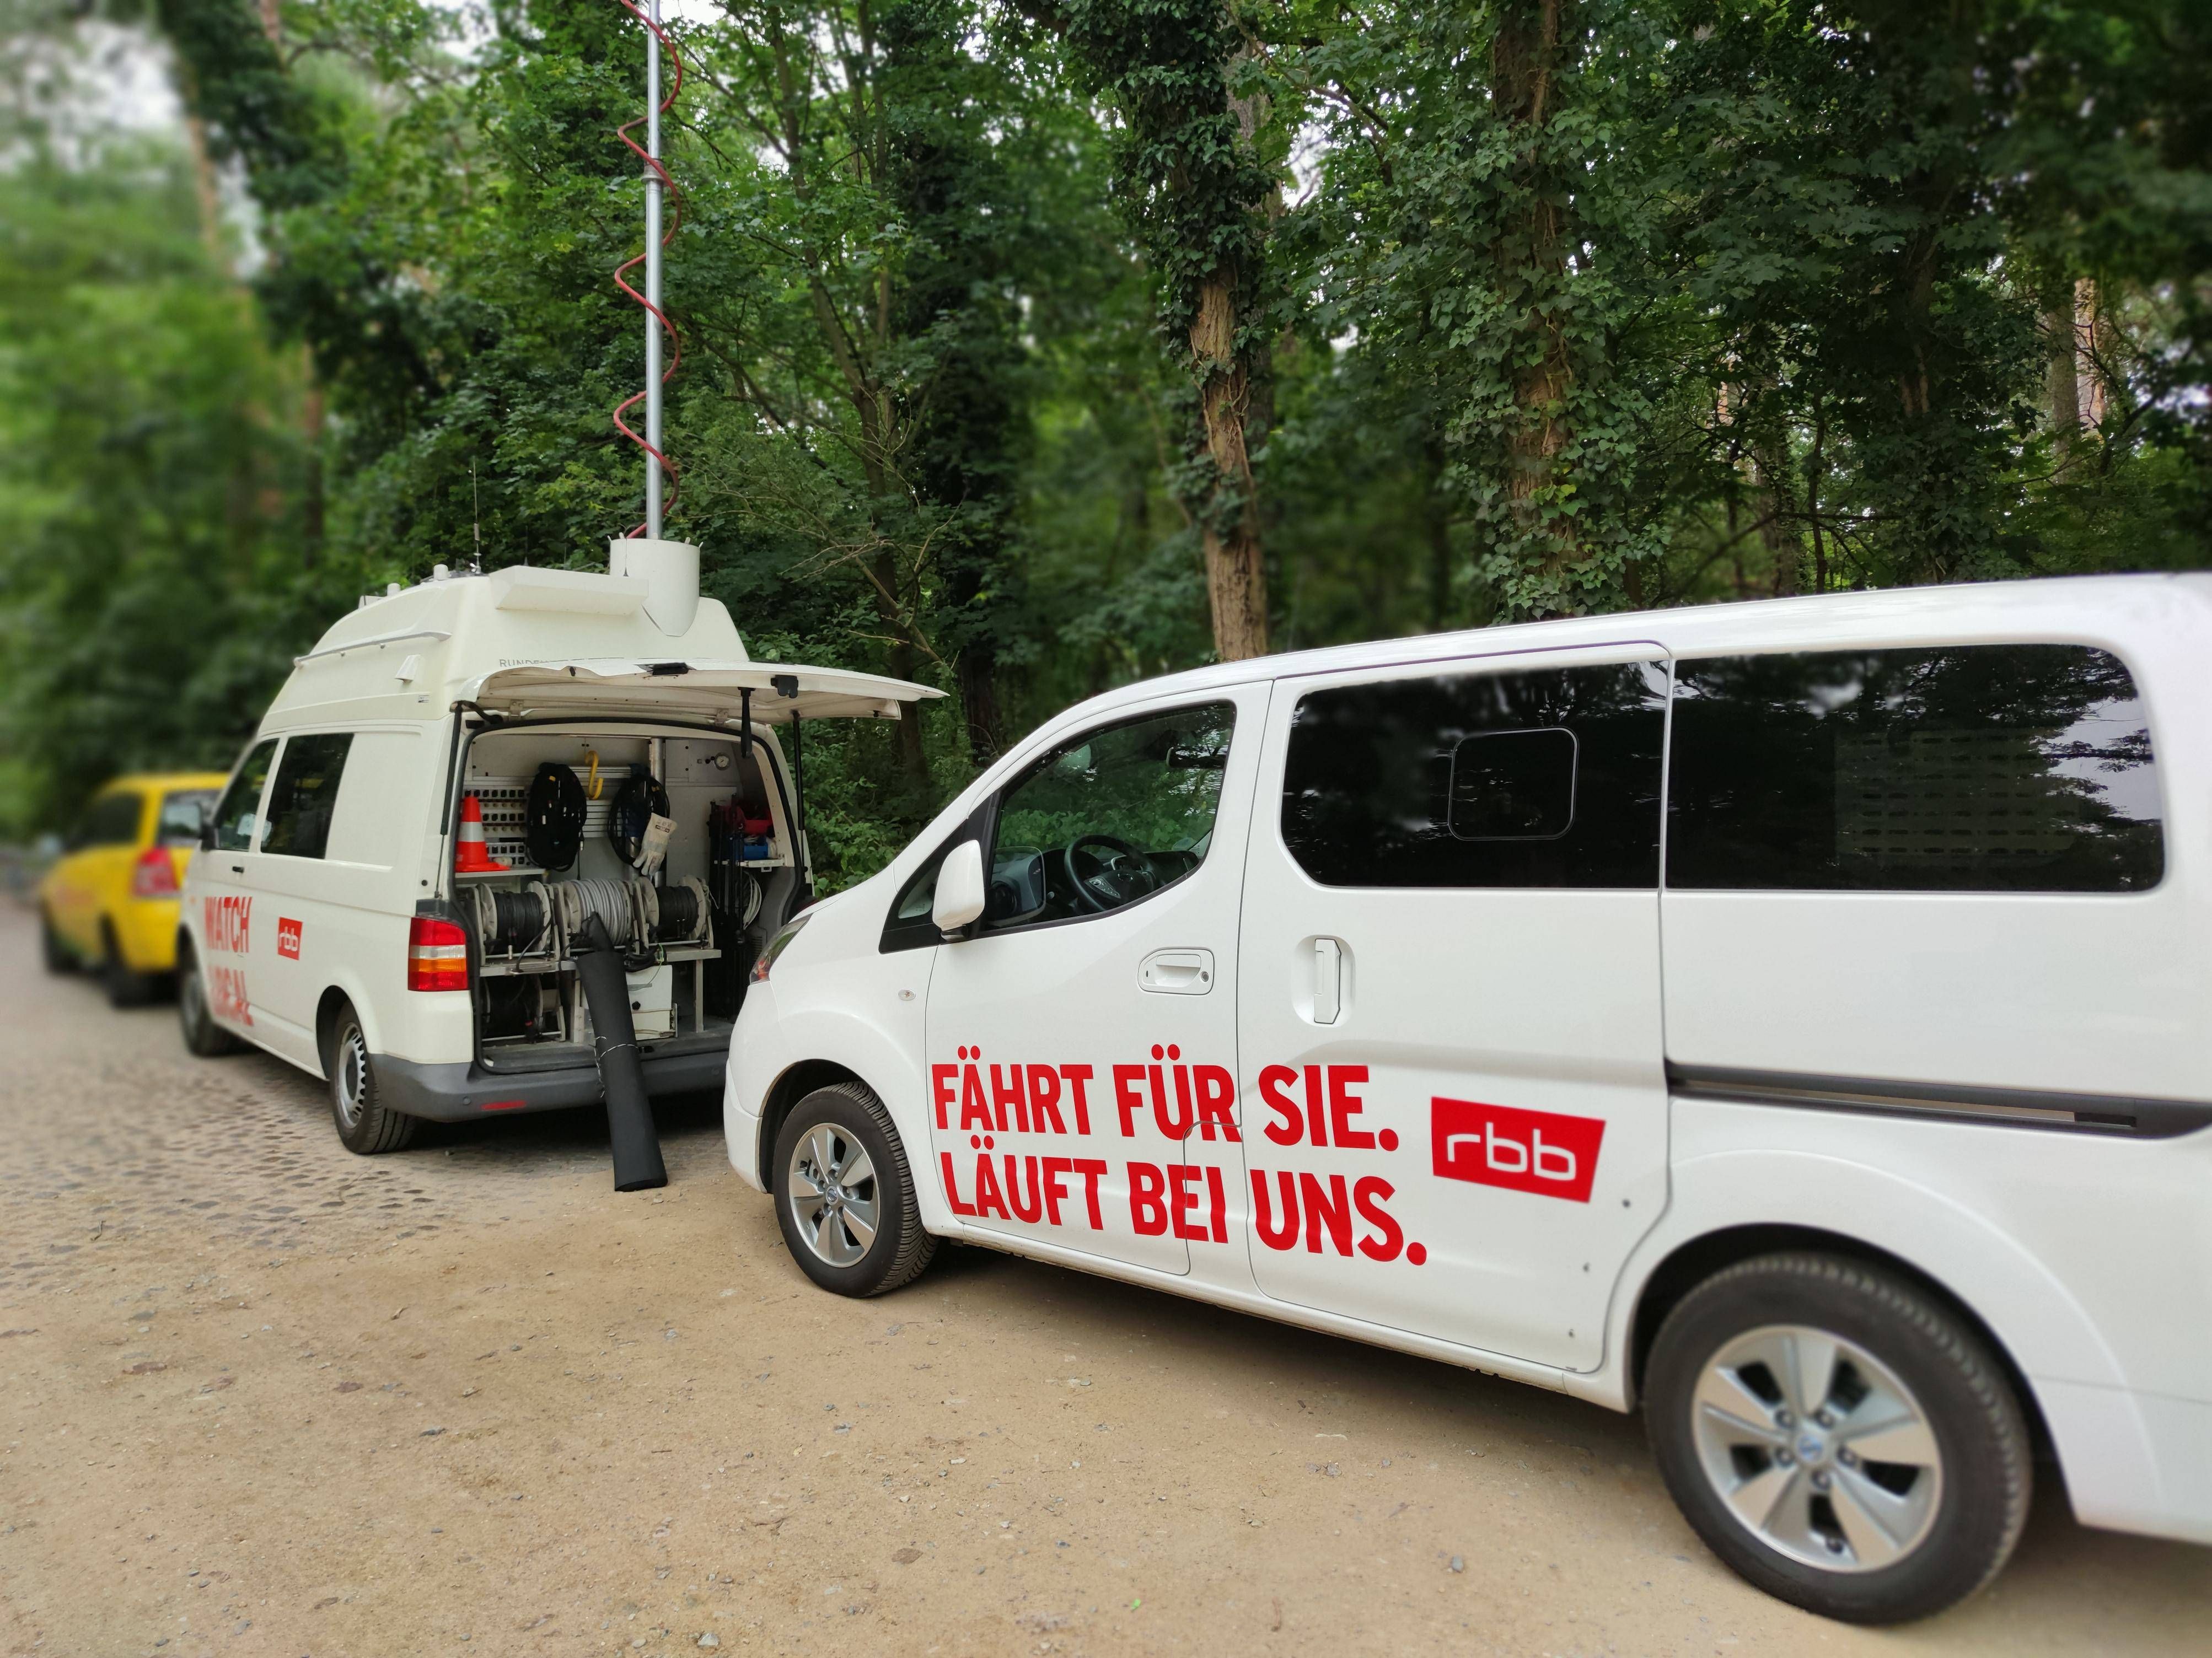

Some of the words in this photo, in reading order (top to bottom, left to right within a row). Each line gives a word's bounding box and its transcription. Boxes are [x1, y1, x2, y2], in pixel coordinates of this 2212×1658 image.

[205, 896, 253, 952] WATCH
[278, 925, 299, 952] rbb
[932, 1044, 1093, 1135] FÄHRT
[1113, 1044, 1242, 1143] FÜR
[1258, 1064, 1399, 1151] SIE.
[1446, 1121, 1577, 1181] rbb
[941, 1134, 1107, 1230] LÄUFT
[1126, 1161, 1228, 1244] BEI
[1250, 1169, 1427, 1266] UNS.
